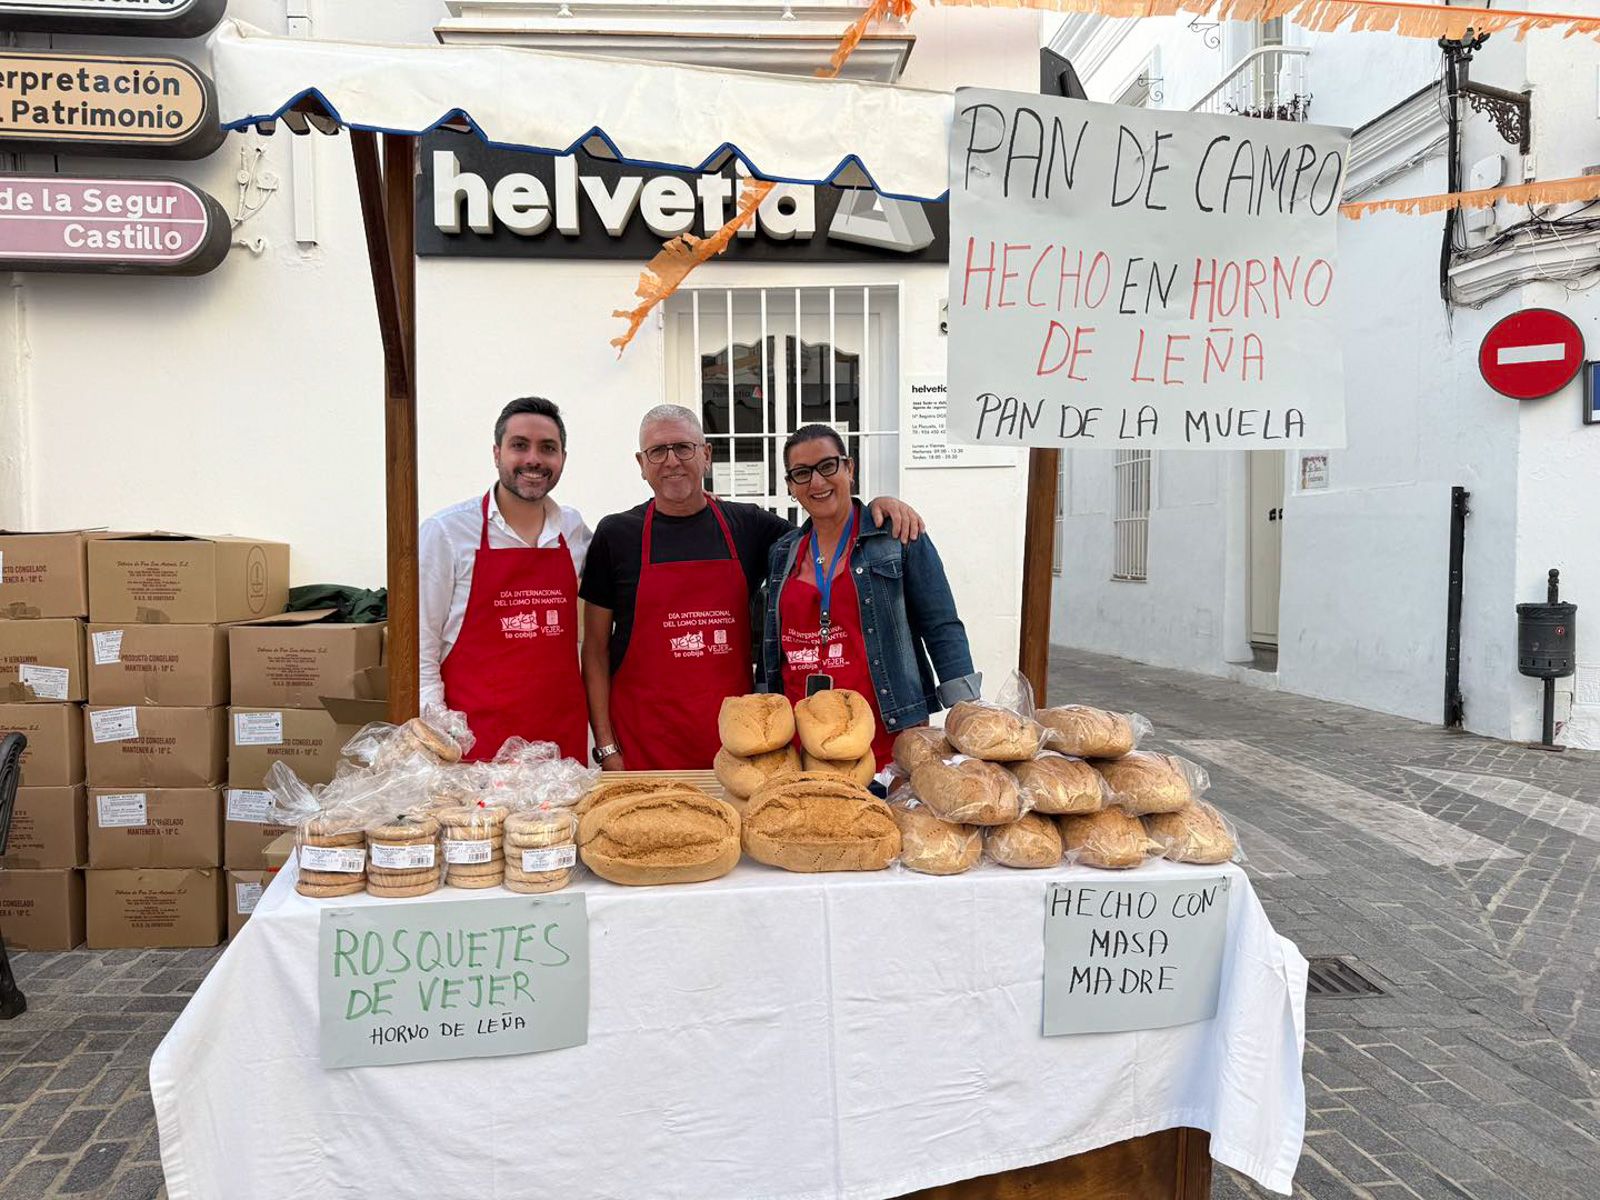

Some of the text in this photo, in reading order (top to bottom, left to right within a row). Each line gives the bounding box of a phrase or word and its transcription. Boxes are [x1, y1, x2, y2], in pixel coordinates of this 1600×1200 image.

[0, 68, 180, 96] rpretación
[12, 100, 183, 129] Patrimonio
[961, 104, 1342, 216] PAN DE CAMPO
[42, 189, 72, 212] la
[82, 189, 178, 219] Segur
[63, 224, 182, 250] Castillo
[962, 237, 1334, 322] HECHO EN HORNO
[1037, 320, 1264, 384] DE LEÑA
[976, 393, 1305, 442] PAN DE LA MUELA
[509, 598, 531, 607] LOMO
[540, 597, 567, 605] MANTECA
[514, 589, 562, 598] INTERNACIONAL
[677, 619, 697, 627] LOMO
[708, 617, 736, 625] MANTECA
[681, 610, 731, 619] INTERNACIONAL
[125, 664, 153, 672] MANTENER
[149, 655, 179, 663] CONGELADO
[122, 746, 149, 754] MANTENER
[146, 737, 176, 745] CONGELADO
[267, 748, 295, 756] MANTENER
[1052, 886, 1217, 920] HECHO CON
[334, 923, 570, 978] ROSQUETES
[1090, 928, 1168, 958] MASA
[346, 970, 535, 1020] DE VEJER
[1069, 966, 1177, 995] MADRE
[369, 1012, 526, 1045] HORNO DE LEÑA
